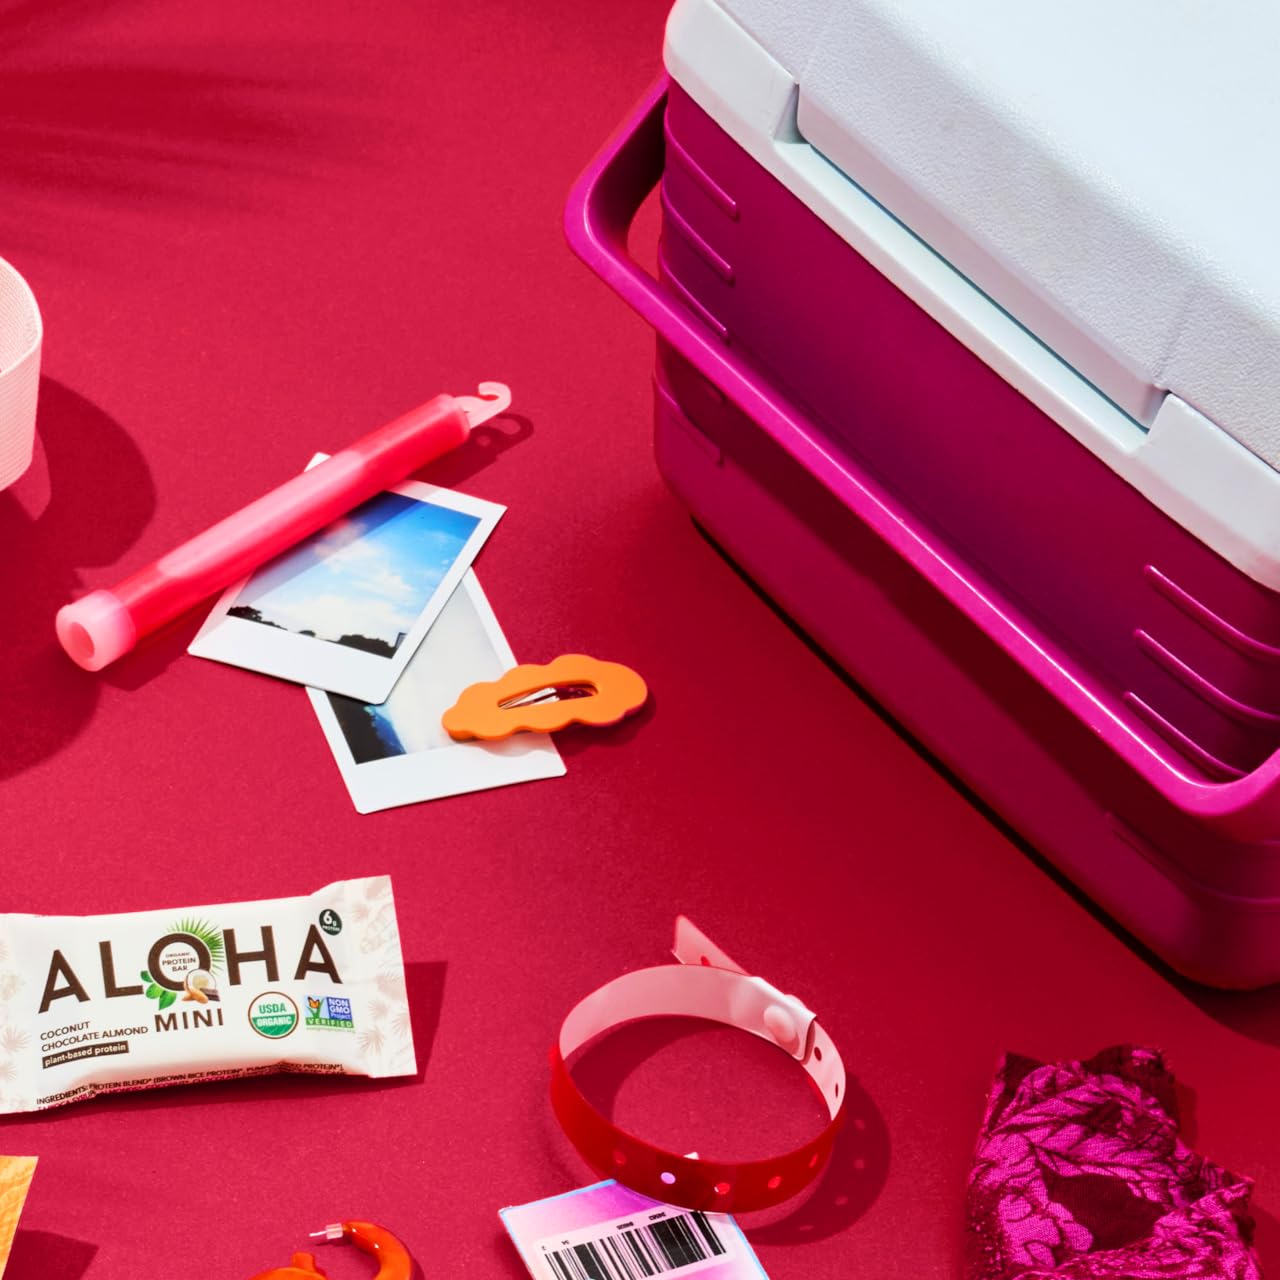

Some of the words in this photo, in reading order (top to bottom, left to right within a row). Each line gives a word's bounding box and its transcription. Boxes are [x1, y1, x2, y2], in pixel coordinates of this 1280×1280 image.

[324, 911, 336, 926] 6g
[38, 924, 343, 1013] ALOHA
[162, 958, 196, 966] PROTEIN
[259, 1003, 286, 1013] USDA
[155, 1008, 223, 1032] MINI
[257, 1016, 292, 1026] ORGANIC
[308, 1018, 352, 1028] VERIFIED
[40, 1021, 90, 1041] COCONUT
[42, 1032, 100, 1052] CHOCOLATE
[102, 1026, 148, 1039] ALMOND
[44, 1048, 93, 1066] plant-based
[95, 1044, 126, 1056] protein
[37, 1085, 88, 1104] INGREDIENTS:
